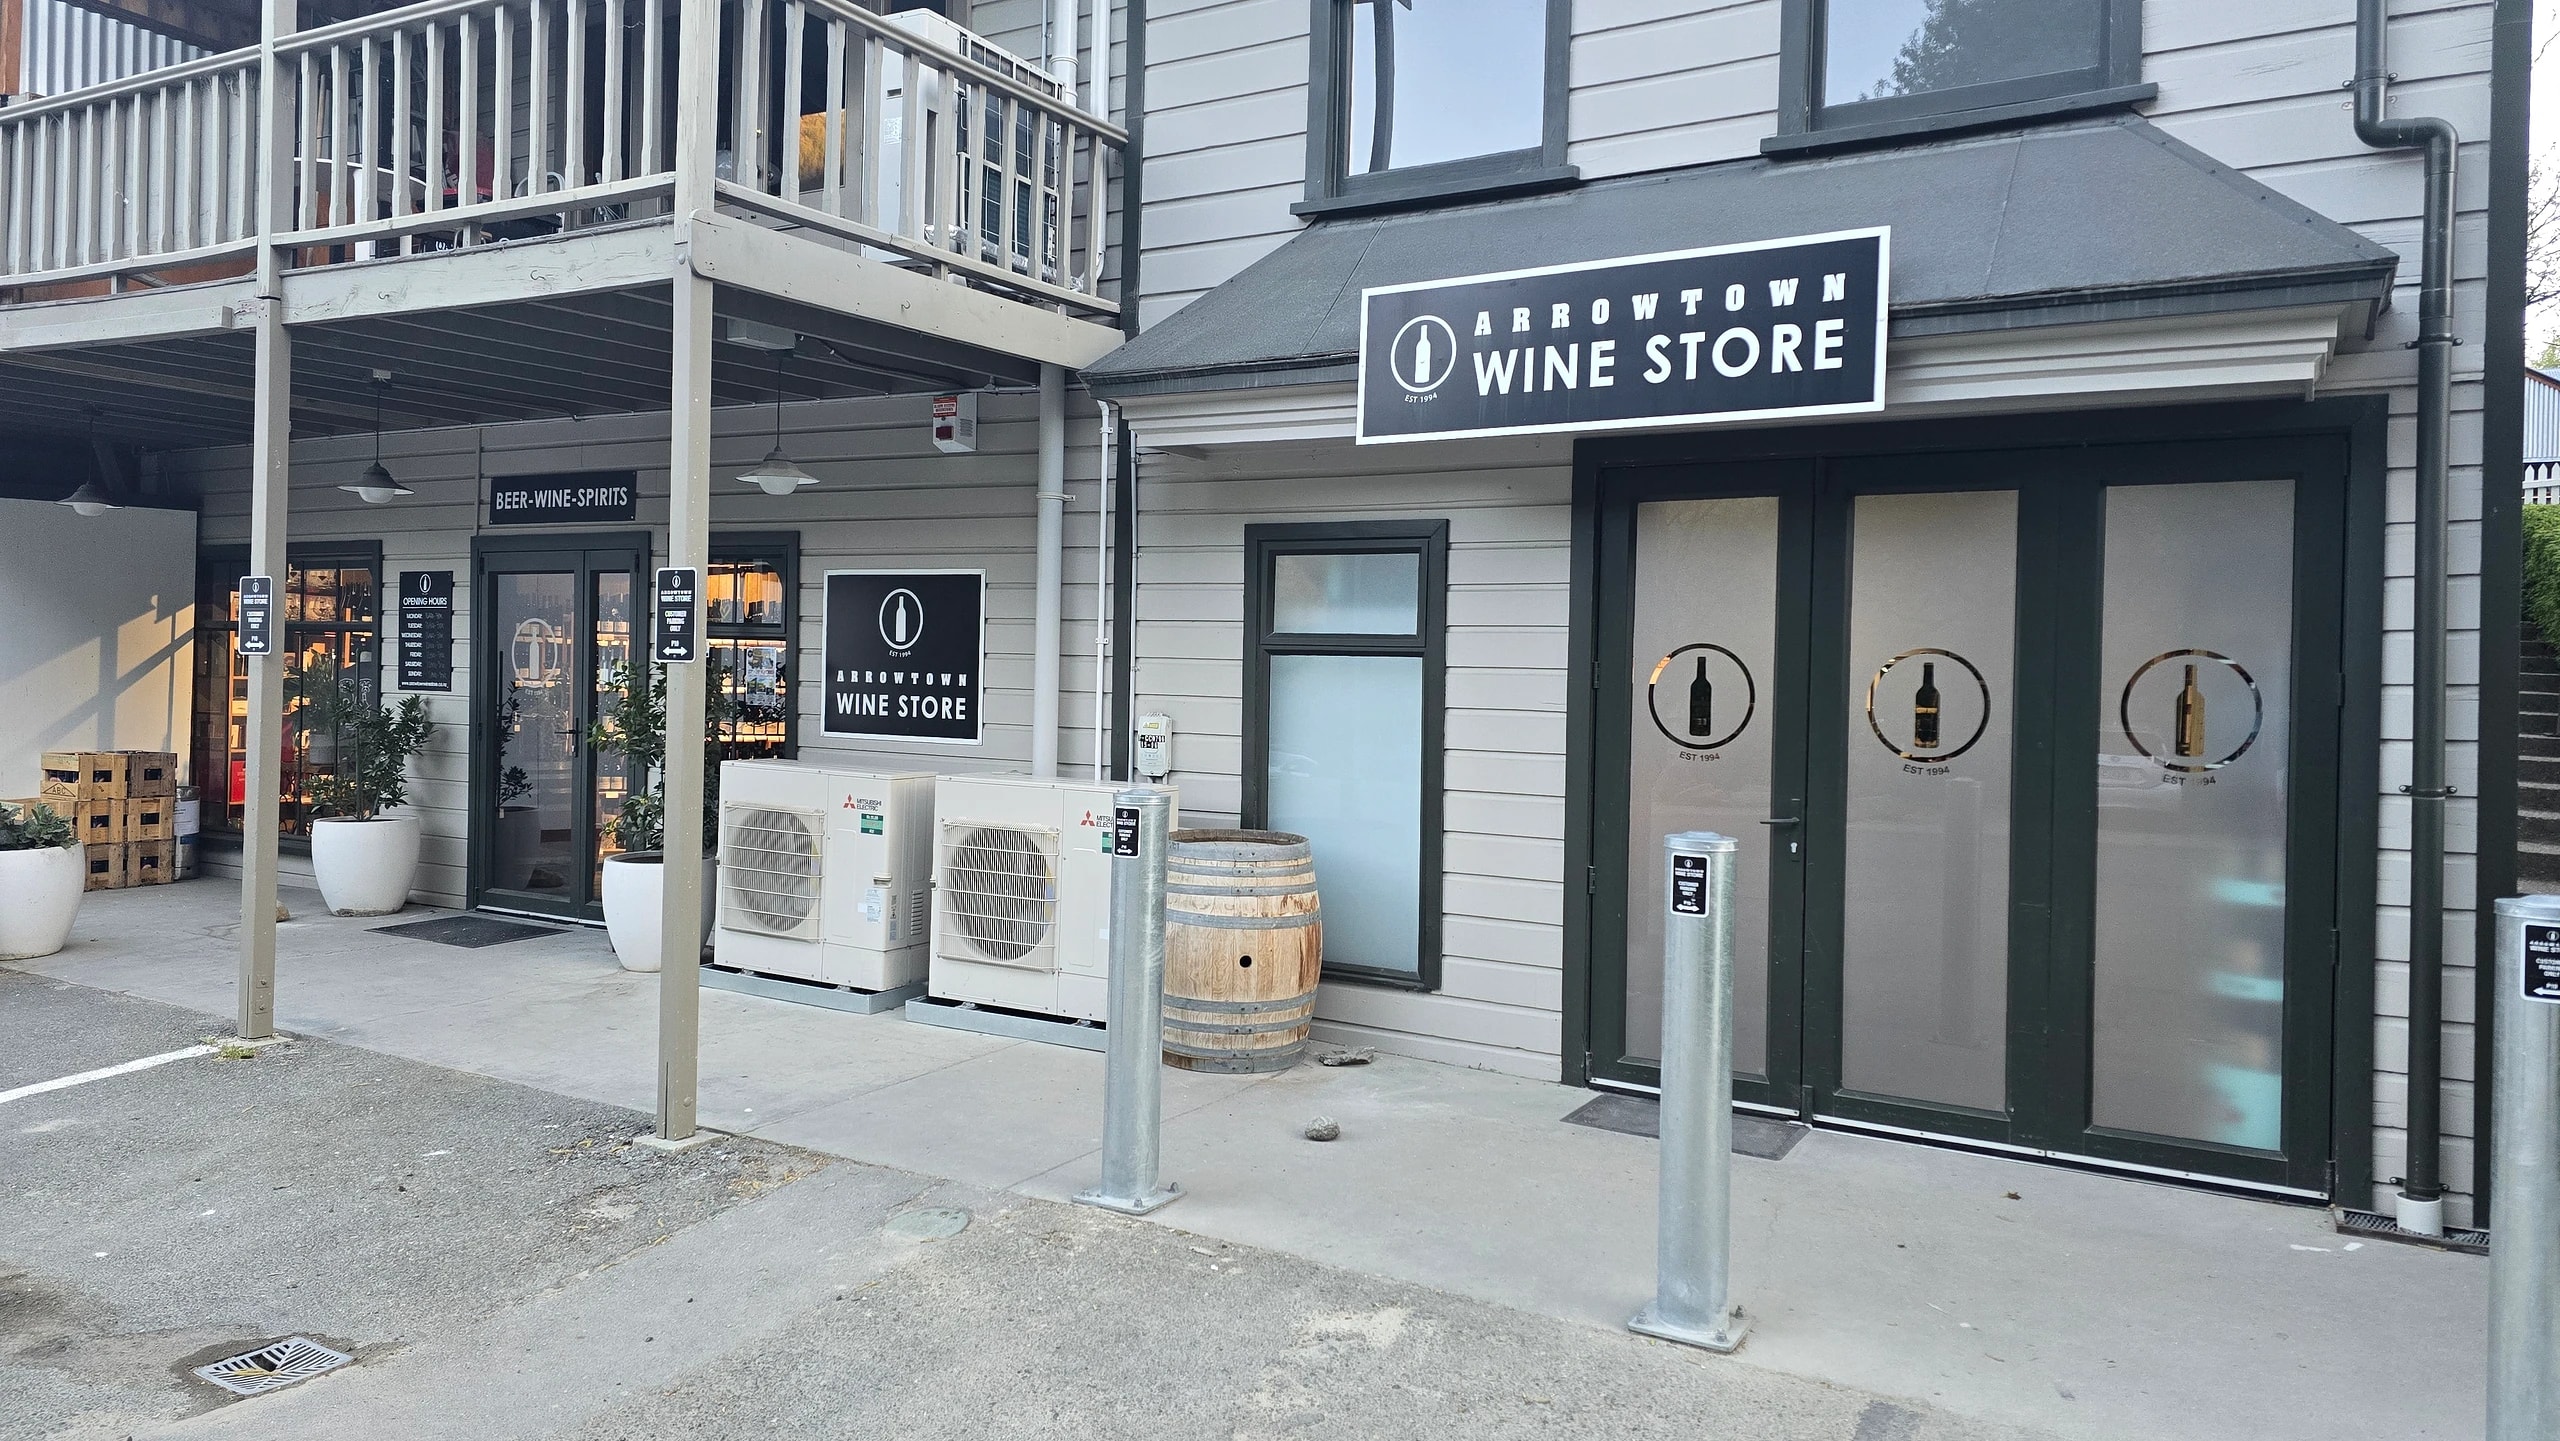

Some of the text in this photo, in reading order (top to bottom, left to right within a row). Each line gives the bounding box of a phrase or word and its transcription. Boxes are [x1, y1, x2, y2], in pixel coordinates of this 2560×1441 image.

[1473, 272, 1847, 337] ARROWTOWN
[1472, 318, 1845, 397] WINE STORE
[1404, 391, 1438, 403] EST 1994
[496, 486, 628, 510] BEER-WINE-SPIRITS
[402, 597, 448, 606] OPENING HOURS
[836, 669, 968, 687] ARROWTOWN
[836, 693, 966, 720] WINE STORE
[1679, 750, 1720, 762] EST 1994
[1903, 764, 1950, 776] EST 1994
[2162, 774, 2186, 786] EST
[856, 798, 882, 806] MITSUBISHI
[856, 804, 879, 812] ELECTRIC
